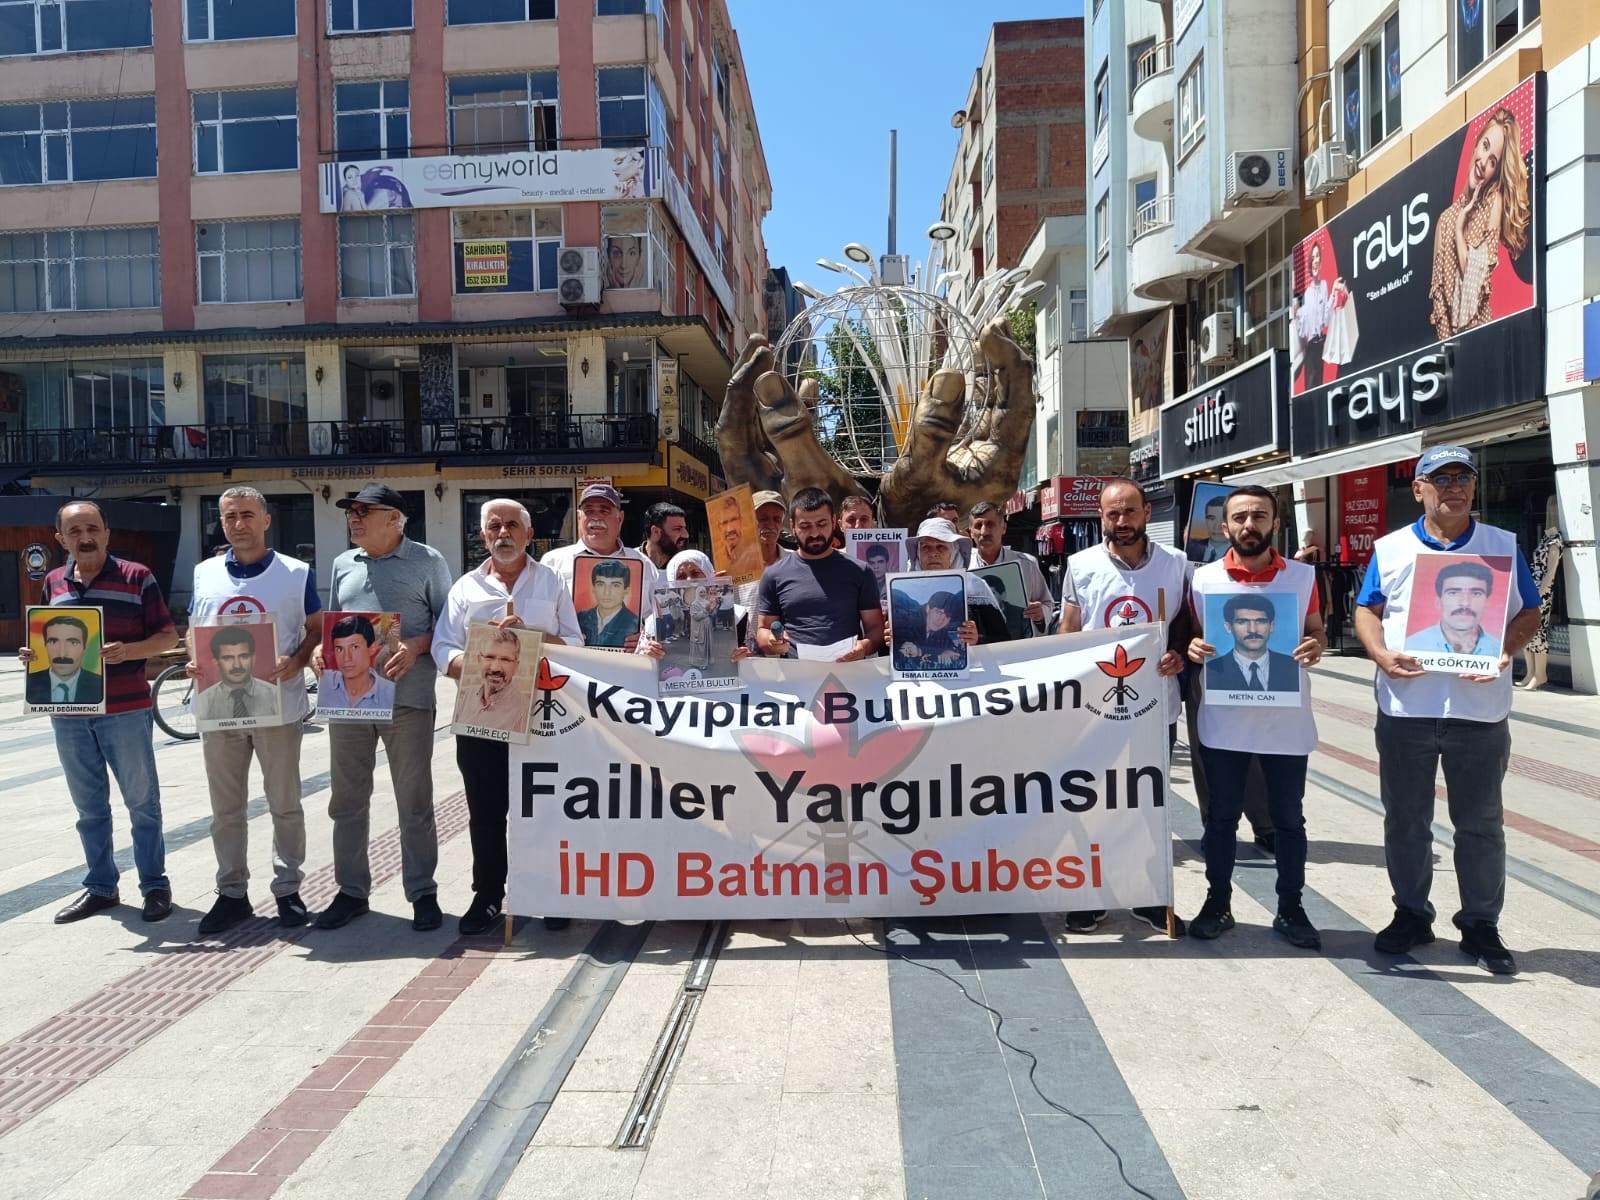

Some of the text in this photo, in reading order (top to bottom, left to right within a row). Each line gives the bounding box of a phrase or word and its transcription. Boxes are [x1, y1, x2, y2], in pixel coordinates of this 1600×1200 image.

[1277, 151, 1286, 187] BEKO
[549, 187, 575, 196] medical
[580, 186, 606, 195] esthetic
[1353, 192, 1430, 279] rays
[1327, 354, 1445, 427] rays
[1184, 388, 1237, 446] stilife
[1430, 450, 1470, 460] adidas
[539, 465, 588, 476] SOFRASI
[1345, 514, 1379, 525] FIRSATLARI
[851, 531, 903, 541] EDİP ÇELİK
[1437, 657, 1490, 671] GÖKTAYI
[665, 678, 736, 690] MERYEM BULUT
[1228, 693, 1254, 701] METİN
[586, 678, 1081, 738] Kayıplar Bulunsun
[520, 762, 1165, 835] Failler Yargılansın
[559, 840, 1102, 906] İHD Batman Şubesi
